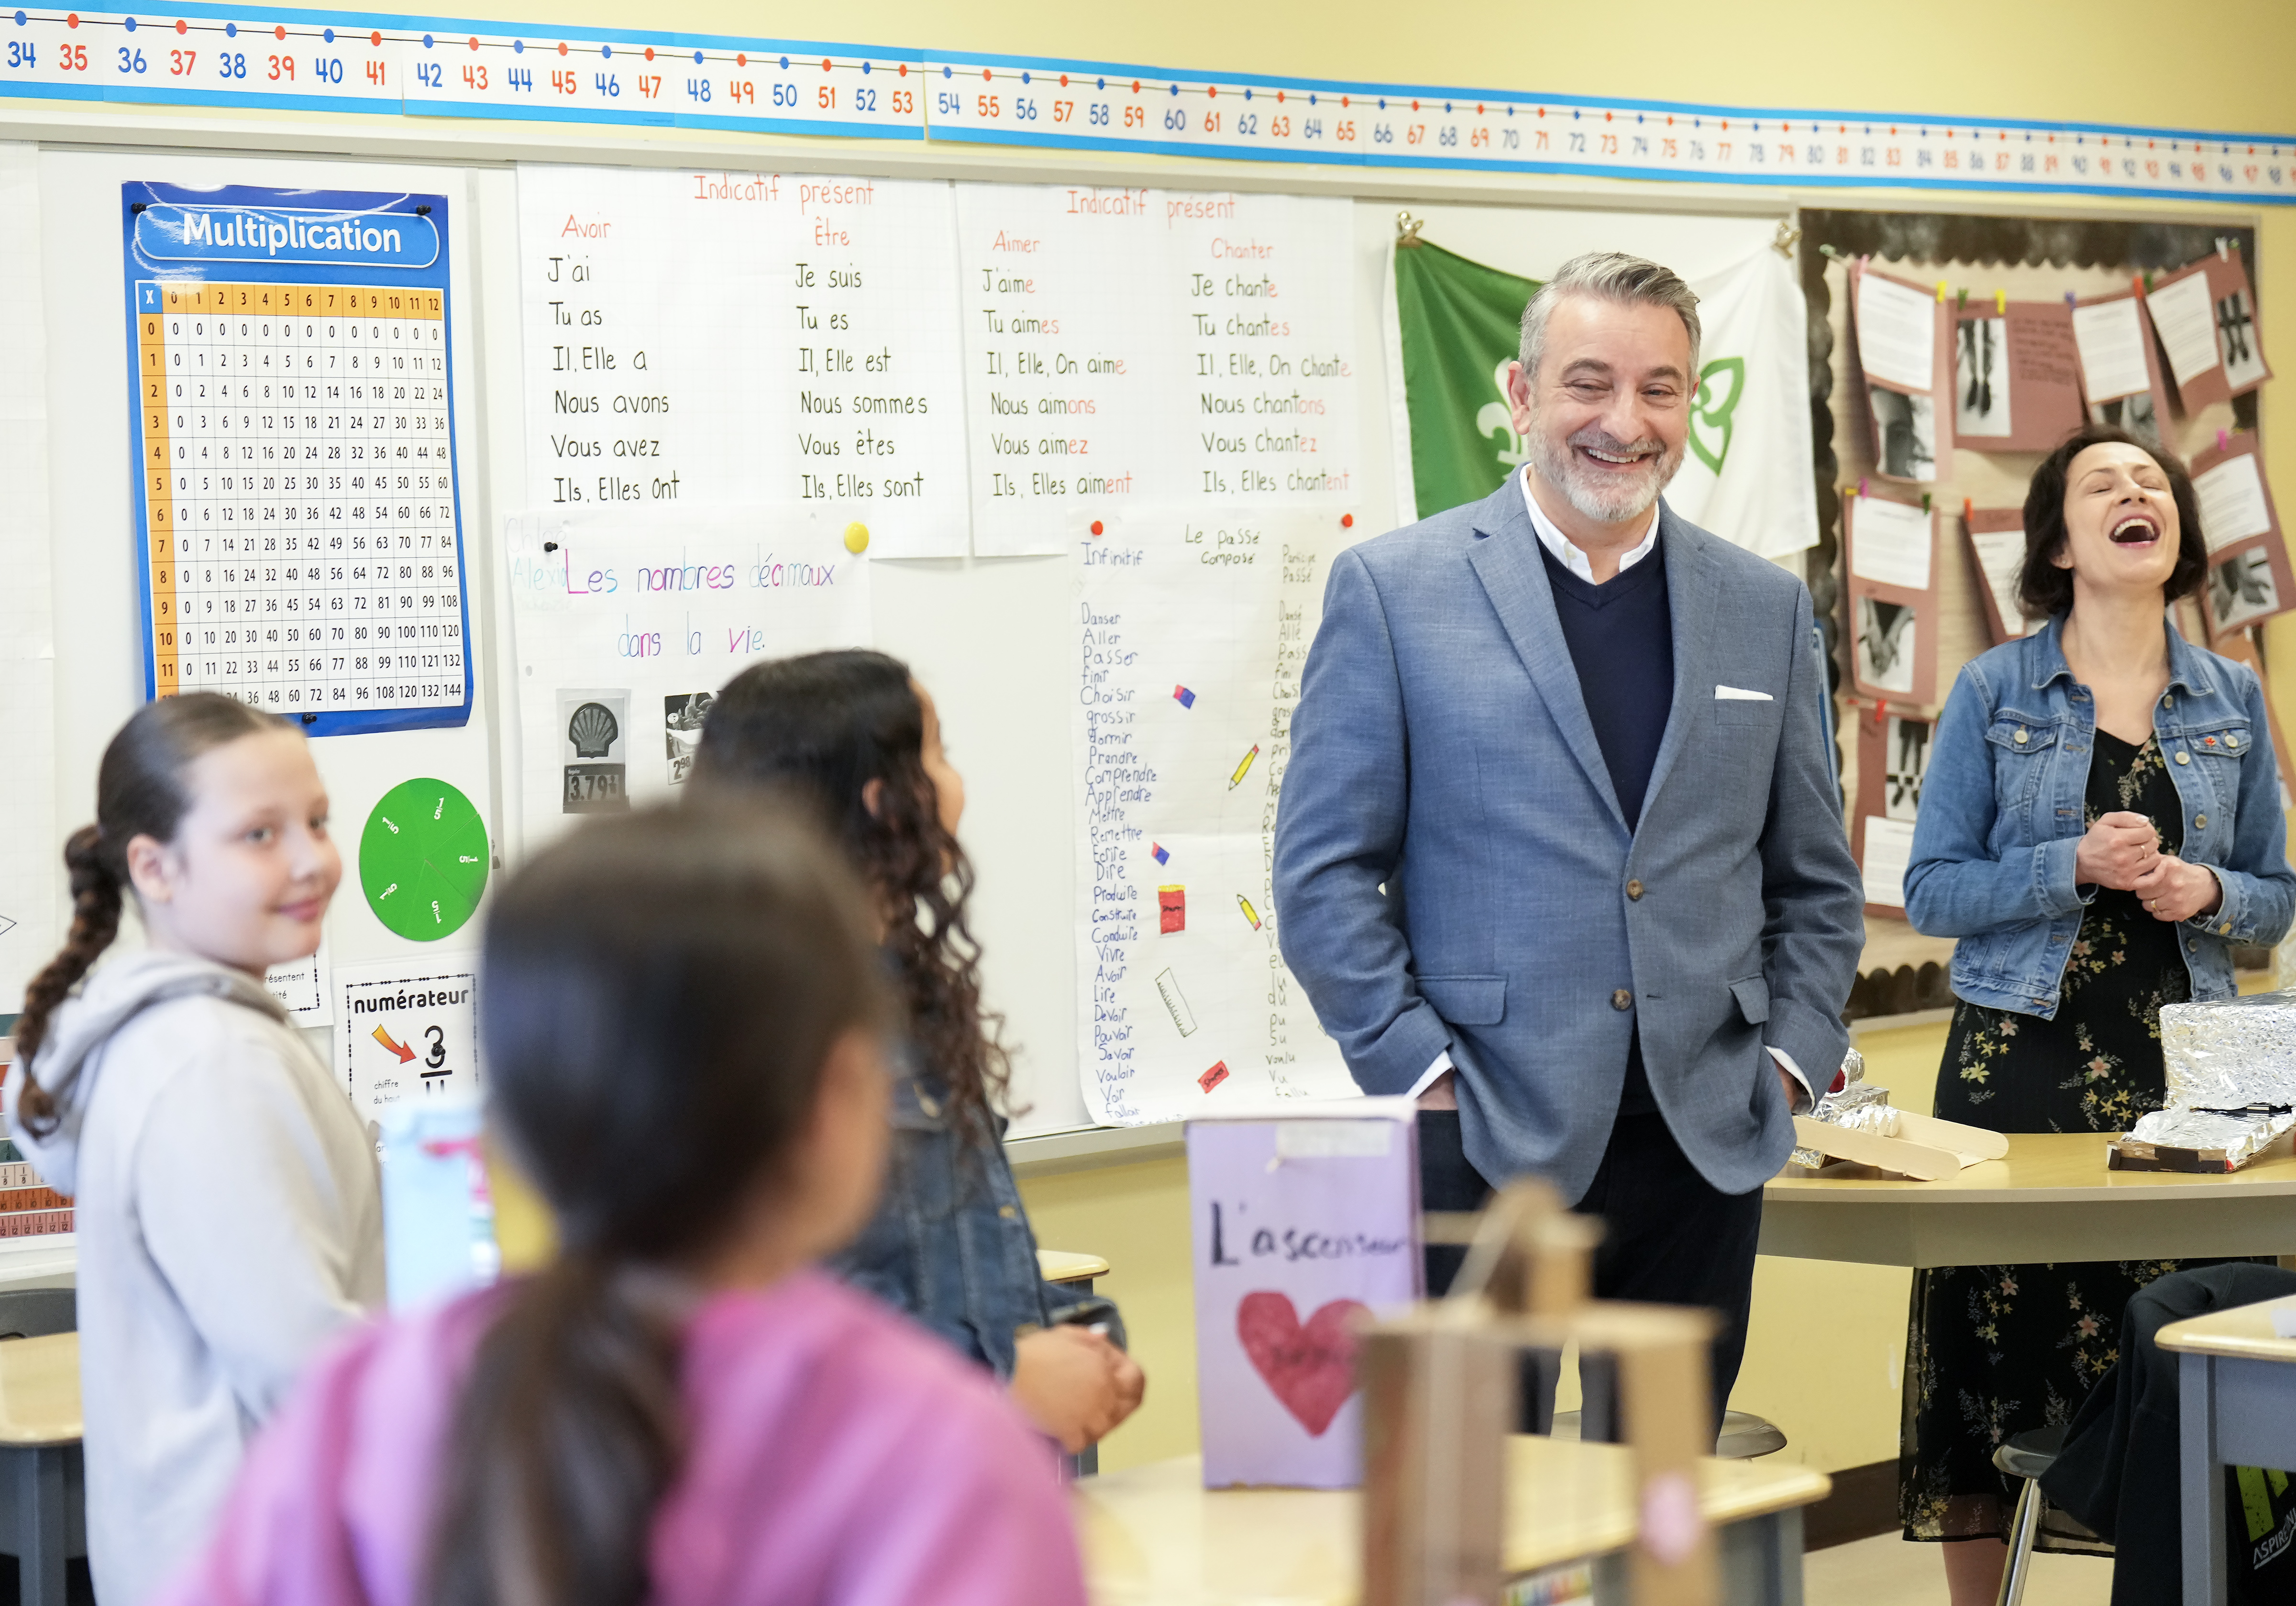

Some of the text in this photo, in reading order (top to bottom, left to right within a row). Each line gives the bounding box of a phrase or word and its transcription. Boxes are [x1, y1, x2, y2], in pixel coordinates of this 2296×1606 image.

[7, 41, 754, 105] 34 35 36 37 38 39 40 41 42 43 44 45 46 47 48 49
[695, 174, 875, 216] Indicatif présent
[1066, 187, 1236, 229] Indicatif présent
[183, 213, 401, 255] Multiplication
[561, 211, 611, 238] Avoir
[815, 216, 850, 246] Être
[992, 230, 1040, 253] Aimer
[1211, 237, 1274, 259] Chanter
[548, 254, 590, 283] J'ai
[795, 262, 862, 288] Je suis
[981, 266, 1036, 294] J'aime
[1191, 273, 1214, 297] Je
[548, 301, 602, 326] Tu as
[795, 305, 849, 330] Tu es
[982, 309, 1059, 334] Tu aimes
[1191, 313, 1216, 337] Tu
[582, 346, 617, 370] Elle
[633, 350, 648, 371] a
[798, 345, 892, 378] Il, Elle est
[986, 351, 1127, 378] Il, Elle, On aime
[1196, 352, 1223, 378] Il,
[1229, 352, 1262, 378] Elle,
[1269, 353, 1292, 376] On
[555, 389, 669, 414] Nous avons
[801, 390, 928, 414] Nous sommes
[991, 391, 1096, 416] Nous aimons
[1201, 392, 1246, 414] Nous
[551, 434, 660, 458] Vous avez
[798, 428, 895, 456] Vous êtes
[991, 432, 1089, 455] Vous aimez
[1201, 431, 1247, 453] Vous
[598, 476, 640, 501] Elles
[801, 471, 925, 500] Ils, Elles sont
[992, 470, 1133, 499] Ils, Elles aiment
[1202, 470, 1235, 495] Ils,
[1241, 469, 1277, 492] Elles
[1185, 524, 1203, 544] Le
[1080, 541, 1143, 566] Infinitif
[562, 543, 835, 594] Les nombres décimaux
[1081, 601, 1121, 626] Danser
[618, 611, 765, 658] dans la vie.
[1082, 627, 1121, 645] Aller
[1084, 646, 1138, 666] Passer
[247, 683, 461, 704] 36 48 60 72 84 96 108 120 132 144
[1081, 684, 1135, 705] Choisir
[1087, 710, 1136, 734] grossir
[1090, 746, 1137, 764] Prendre
[1085, 763, 1156, 786] Comprendre
[570, 775, 607, 800] 3.79
[1085, 784, 1151, 812] Apprendre
[1091, 824, 1142, 844] Remettre
[1097, 862, 1126, 881] Dire
[1094, 884, 1137, 904] Produire
[1092, 925, 1137, 943] Conduire
[1096, 944, 1124, 962] Vivre
[1095, 964, 1126, 982] Avoir
[355, 989, 469, 1014] numérateur
[1094, 985, 1115, 1003] Lire
[1094, 1004, 1126, 1023] Devoir
[425, 1025, 446, 1068] 3
[374, 1079, 399, 1089] chiffre
[1101, 1084, 1124, 1102] Voir
[374, 1095, 382, 1104] du
